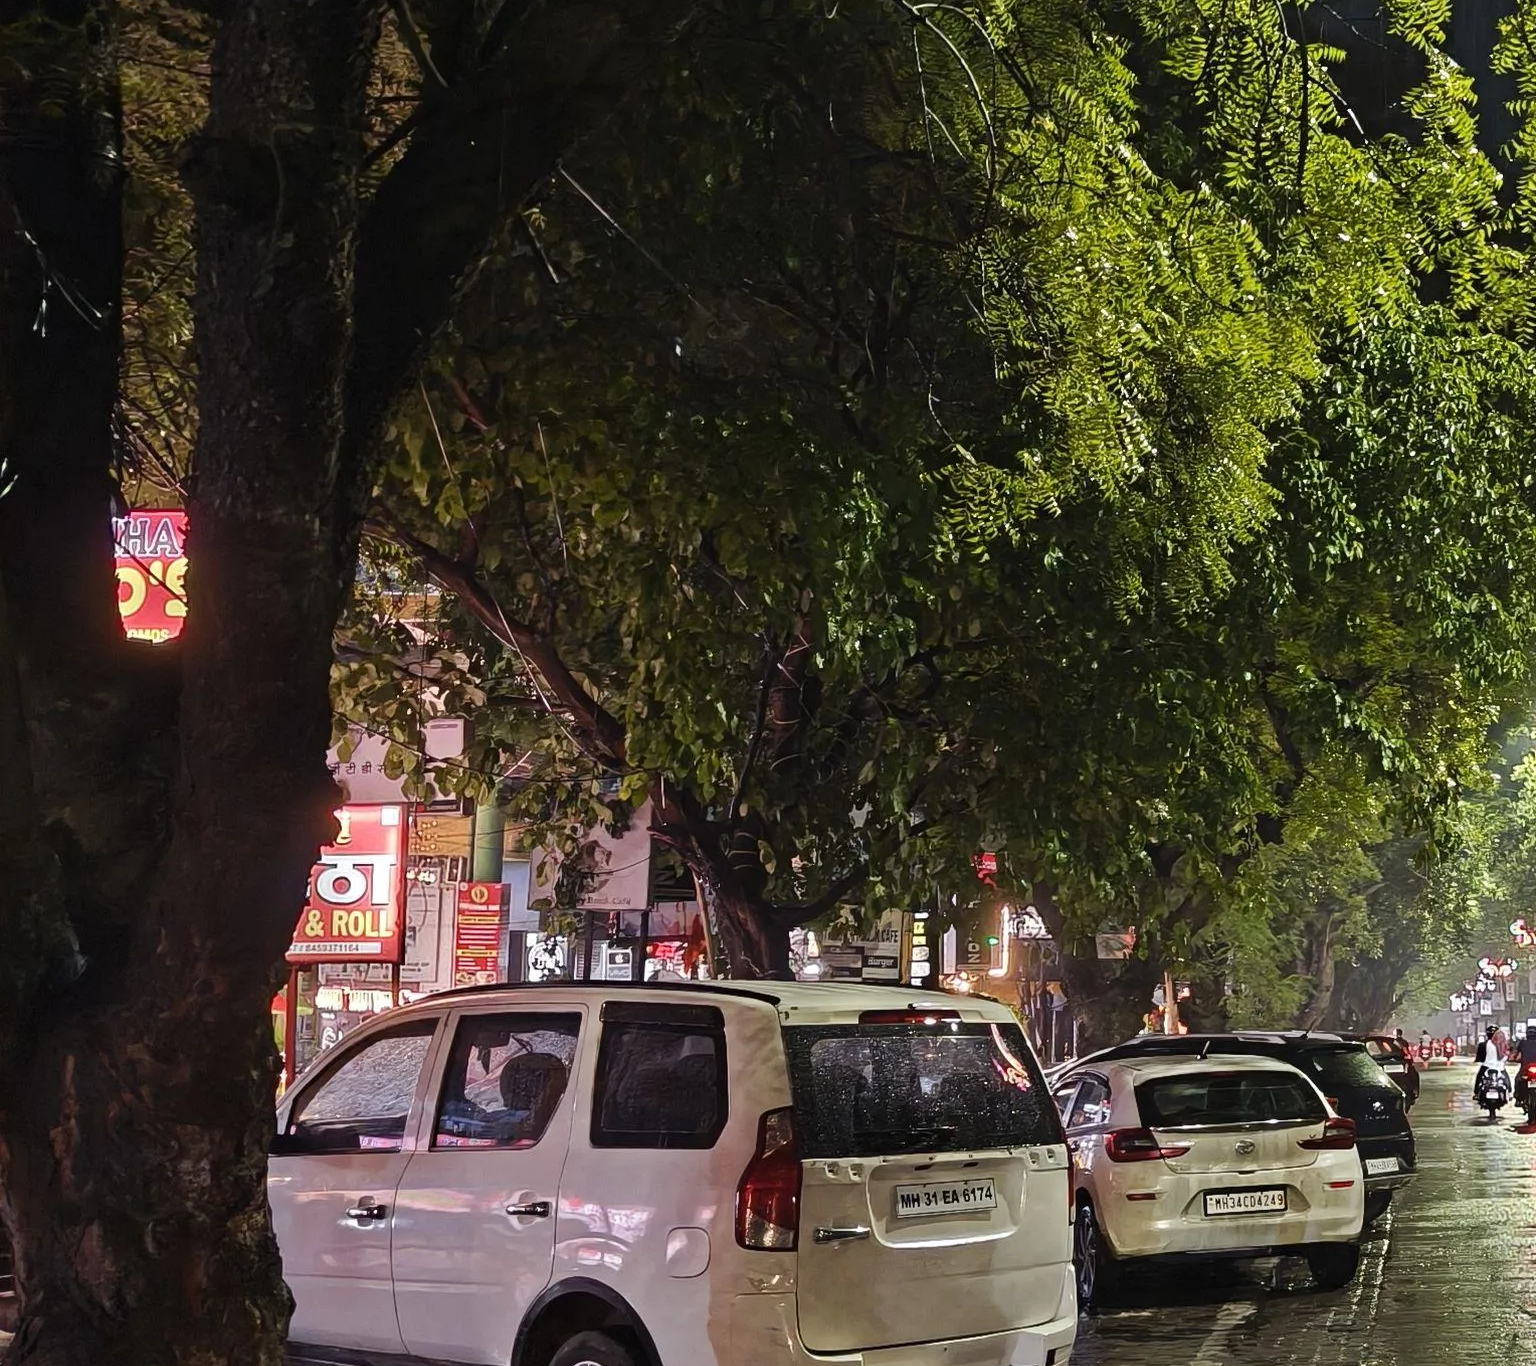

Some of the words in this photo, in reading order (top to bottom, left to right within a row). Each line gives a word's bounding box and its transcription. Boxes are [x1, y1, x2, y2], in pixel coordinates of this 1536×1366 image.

[305, 909, 324, 937] &
[332, 910, 393, 937] ROLL
[901, 1193, 920, 1208] MH
[924, 1191, 938, 1206] 31
[942, 1189, 960, 1204] EA
[963, 1185, 993, 1202] 6174
[1215, 1193, 1283, 1210] MH34CD4249
